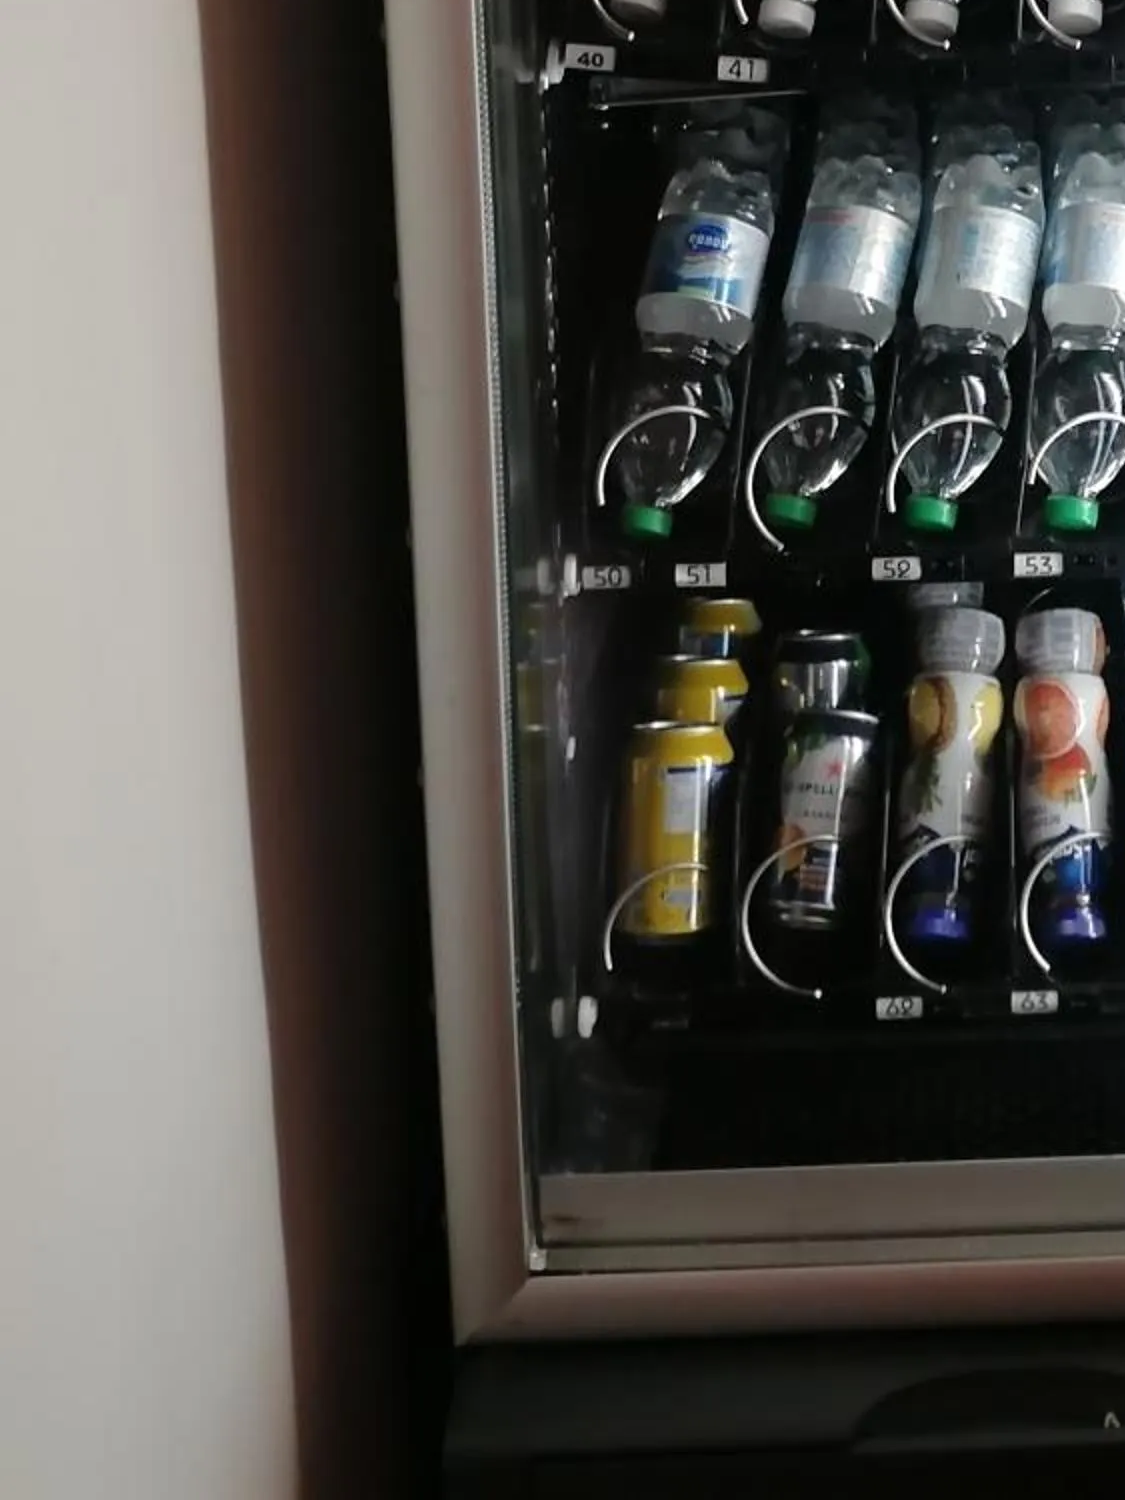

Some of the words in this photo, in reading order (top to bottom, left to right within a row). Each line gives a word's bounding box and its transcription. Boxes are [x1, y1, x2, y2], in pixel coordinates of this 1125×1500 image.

[577, 52, 604, 68] 40
[728, 59, 754, 80] 41
[686, 564, 711, 585] 51
[883, 559, 910, 579] 52
[1025, 555, 1053, 575] 53
[593, 566, 622, 587] 50
[886, 997, 914, 1017] 62
[1021, 991, 1048, 1012] 63
